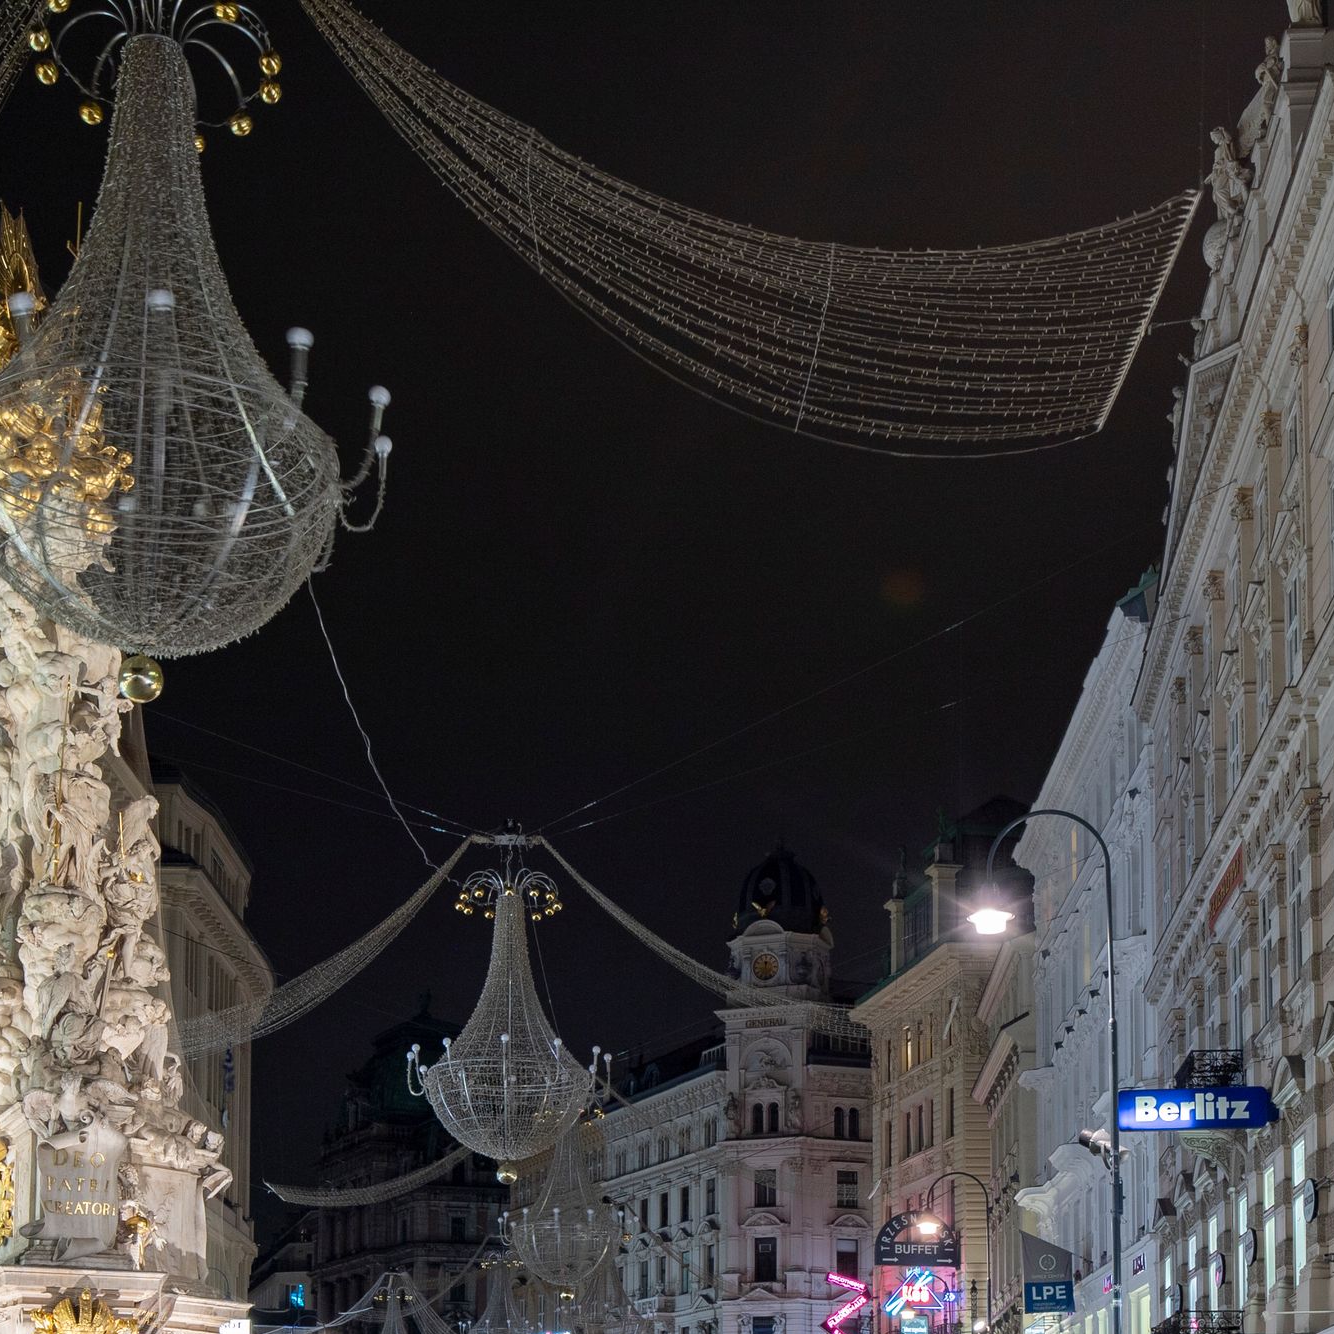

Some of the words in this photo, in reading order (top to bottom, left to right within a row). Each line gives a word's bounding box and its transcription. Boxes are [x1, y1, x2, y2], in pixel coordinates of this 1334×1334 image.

[1135, 1093, 1250, 1122] Berlitz
[54, 1149, 105, 1168] DEO
[47, 1176, 109, 1191] PATRI
[45, 1200, 116, 1216] CREATORI
[880, 1213, 955, 1252] TRZESNSKI
[895, 1244, 939, 1255] BUFFET
[1032, 1285, 1066, 1300] LPE
